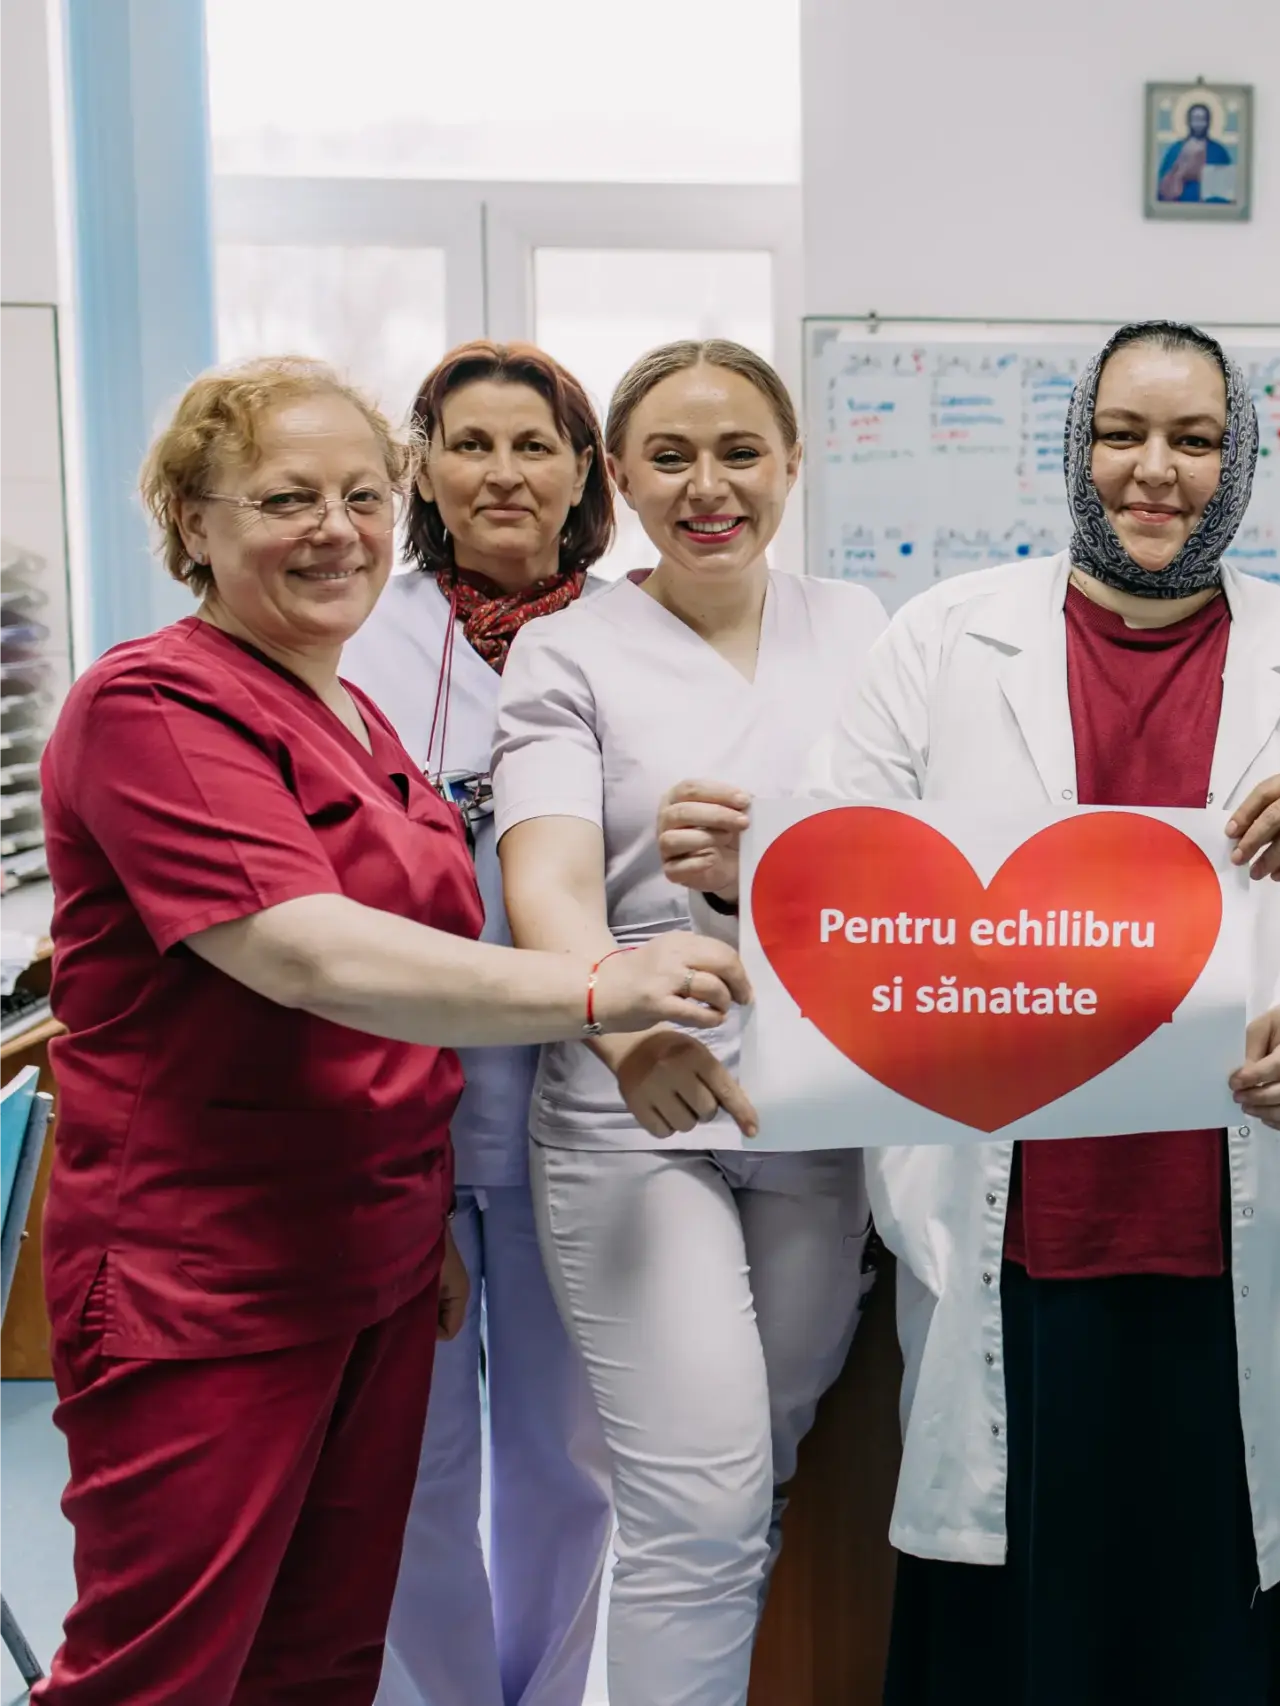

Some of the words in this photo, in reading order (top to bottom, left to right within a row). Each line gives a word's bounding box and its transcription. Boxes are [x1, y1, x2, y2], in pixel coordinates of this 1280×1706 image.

[820, 908, 956, 946] Pentru
[969, 908, 1156, 949] echilibru
[871, 975, 903, 1013] si
[915, 975, 1098, 1015] sănatate
